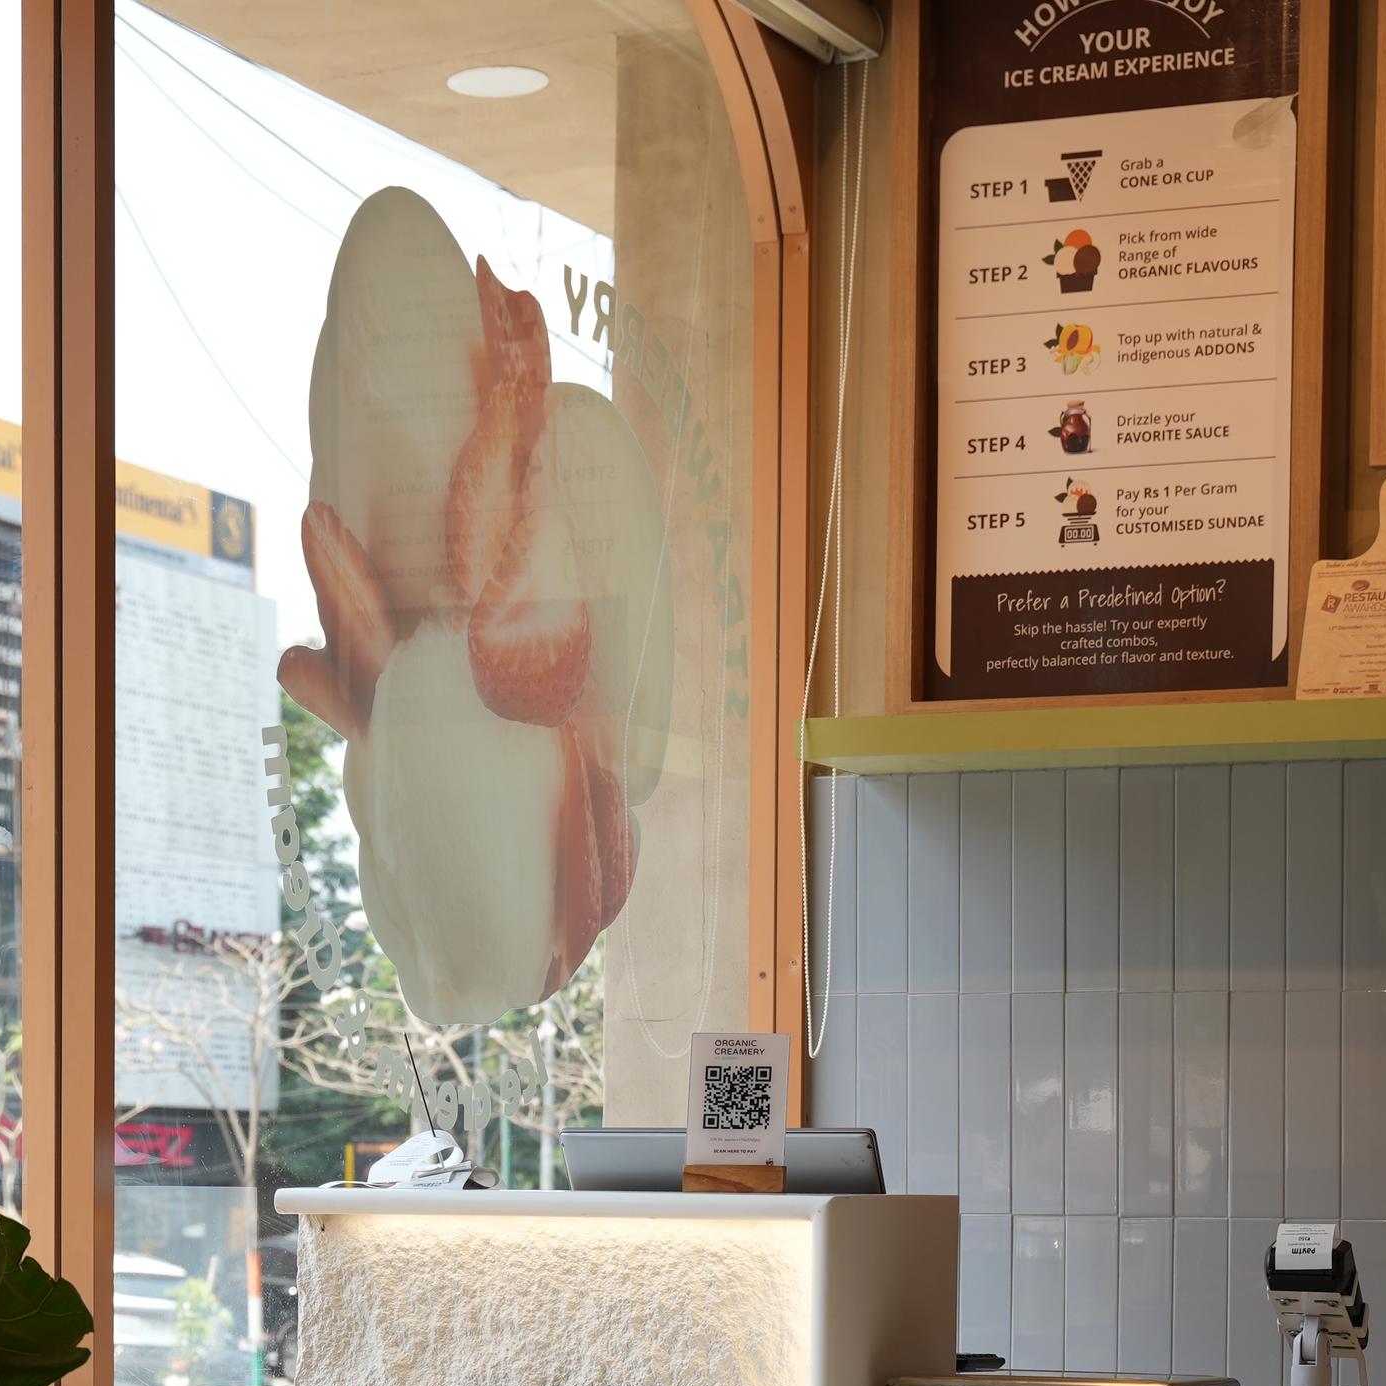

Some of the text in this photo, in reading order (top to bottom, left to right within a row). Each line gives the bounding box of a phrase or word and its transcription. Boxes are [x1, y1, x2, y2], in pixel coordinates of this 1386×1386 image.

[1079, 26, 1152, 55] YOUR
[1004, 47, 1235, 88] ICE CREAM EXPERIENCE
[1120, 158, 1165, 172] Grab a
[1120, 169, 1214, 189] CONE OR CUP
[969, 180, 1028, 200] STEP 1
[1119, 225, 1218, 246] Pick from wide
[1119, 246, 1177, 265] Range of
[969, 265, 1028, 284] STEP 2
[1118, 257, 1259, 281] ORGANIC FLAVOURS
[1118, 323, 1262, 347] Top up with natural &
[1117, 341, 1255, 364] indigenous ADDONS
[968, 357, 1026, 377] STEP 3
[1117, 412, 1196, 427] Drizzle your
[1117, 425, 1230, 444] FAVORITE SAUCE
[967, 435, 1026, 455] STEP 4
[1116, 483, 1238, 503] Pay Rs 1 Per Gram
[967, 512, 1026, 530] STEP 5
[1116, 504, 1169, 518] for your
[1115, 515, 1264, 535] CUSTOMISED SUNDAE
[997, 589, 1052, 613] Prefer
[1060, 595, 1069, 609] a
[1078, 583, 1163, 609] Predefined
[714, 1048, 766, 1056] CREAMERY
[715, 1039, 757, 1047] ORGANIC
